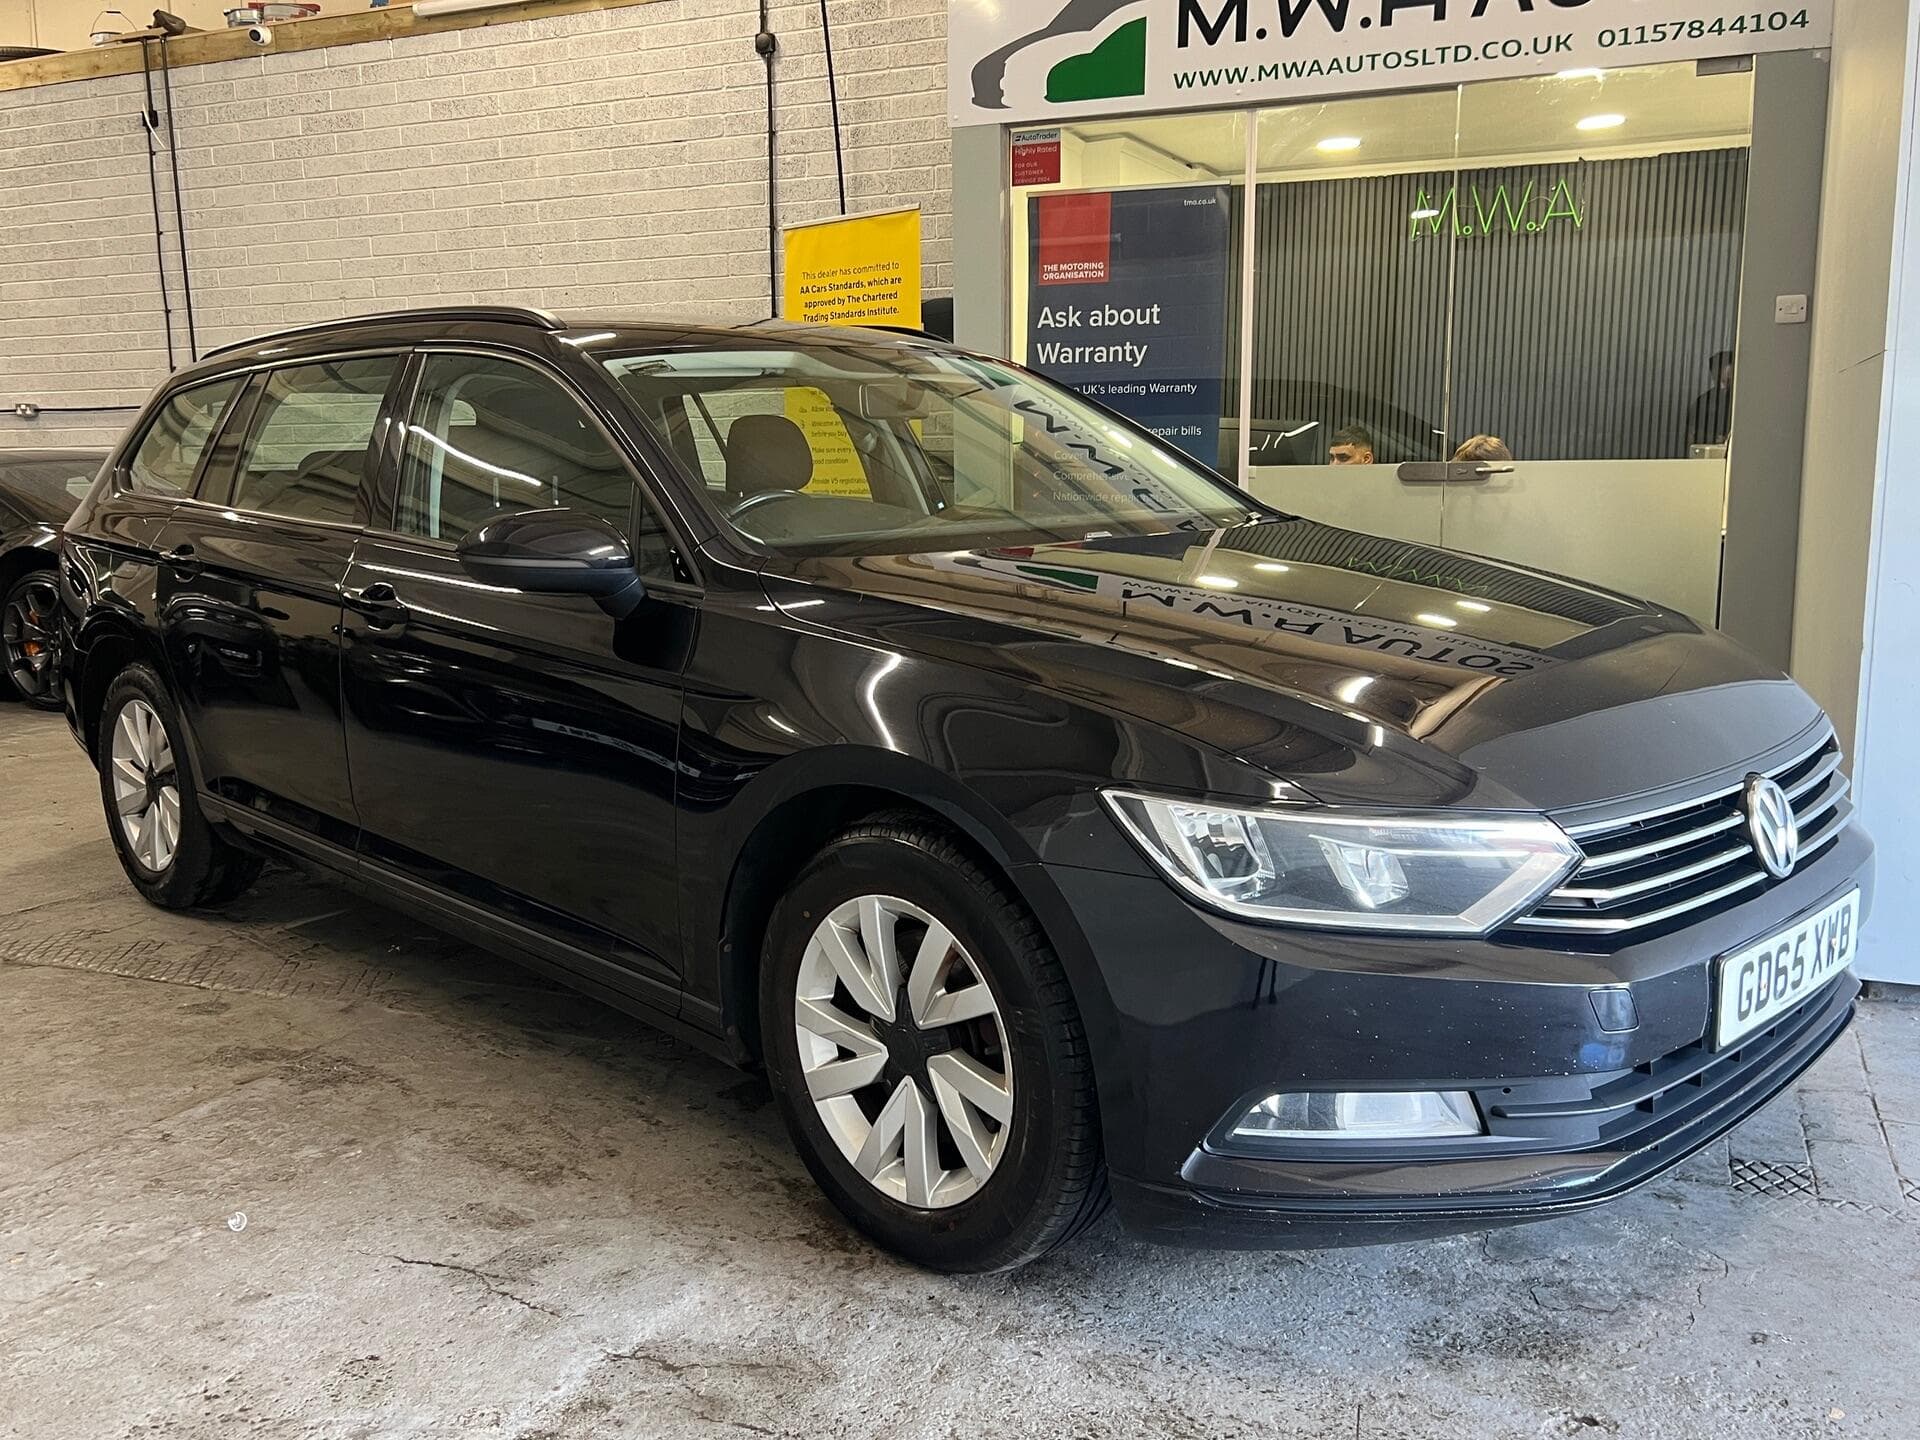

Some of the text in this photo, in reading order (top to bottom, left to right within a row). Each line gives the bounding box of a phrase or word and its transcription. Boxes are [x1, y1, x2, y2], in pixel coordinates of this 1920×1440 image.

[1173, 9, 1809, 89] WWW.MWAAUTOSLTD.CO.UK 01157844104
[1411, 177, 1581, 241] M.W.A
[802, 261, 899, 281] This dealer has committed to
[1042, 270, 1104, 281] ORGANISATION
[1043, 262, 1104, 272] THE MOTORING
[800, 285, 810, 295] AA
[811, 284, 827, 294] Cars
[867, 277, 889, 288] which
[890, 276, 902, 285] are
[804, 290, 898, 310] approved by The Chartered
[803, 306, 900, 323] Trading Standards Institute.
[1037, 303, 1161, 329] Ask about
[1036, 341, 1148, 368] Warranty
[1108, 383, 1147, 396] leading
[1149, 382, 1198, 396] Warranty
[837, 430, 847, 438] buy
[1148, 425, 1202, 438] repair bills
[1054, 450, 1085, 461] Cover
[1737, 903, 1851, 1022] GD65 XWB
